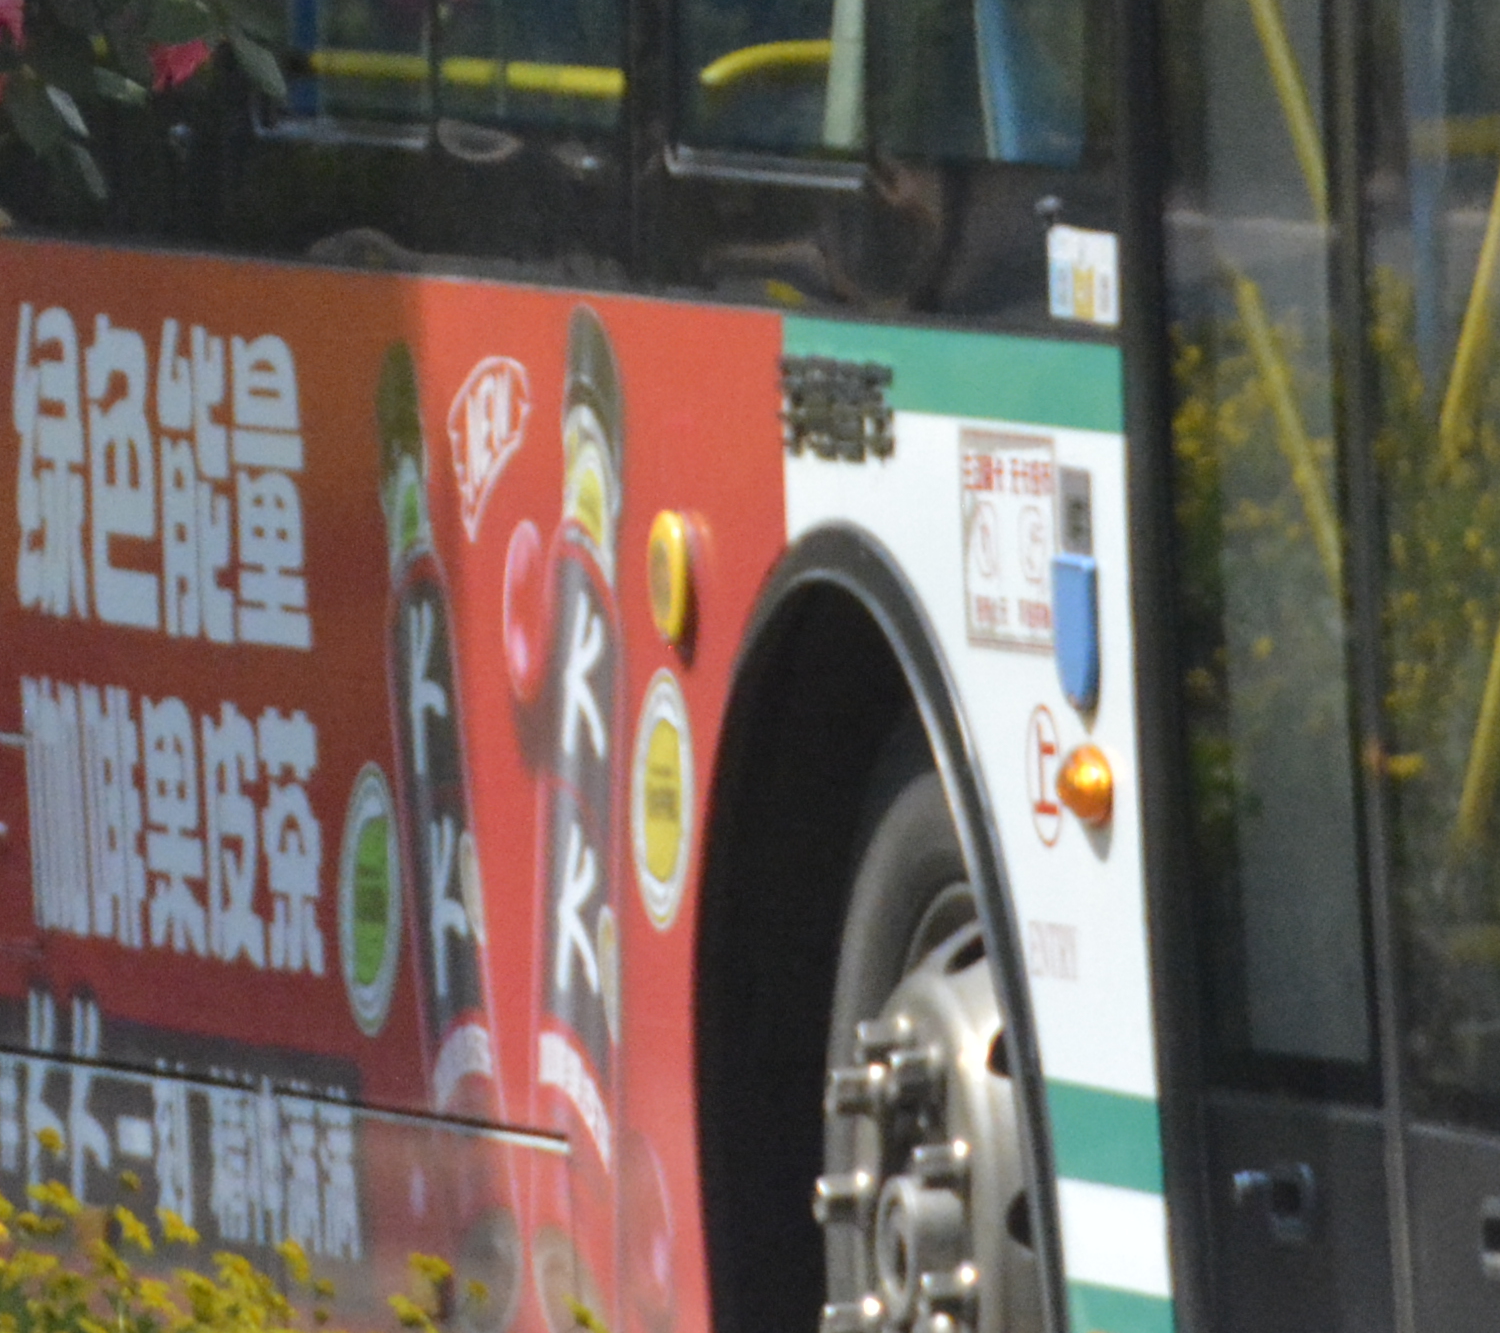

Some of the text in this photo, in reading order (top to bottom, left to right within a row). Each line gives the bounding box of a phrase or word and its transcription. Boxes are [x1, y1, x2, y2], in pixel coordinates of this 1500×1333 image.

[12, 301, 314, 650] 绿色能量
[21, 673, 325, 976] 咖啡果皮茶
